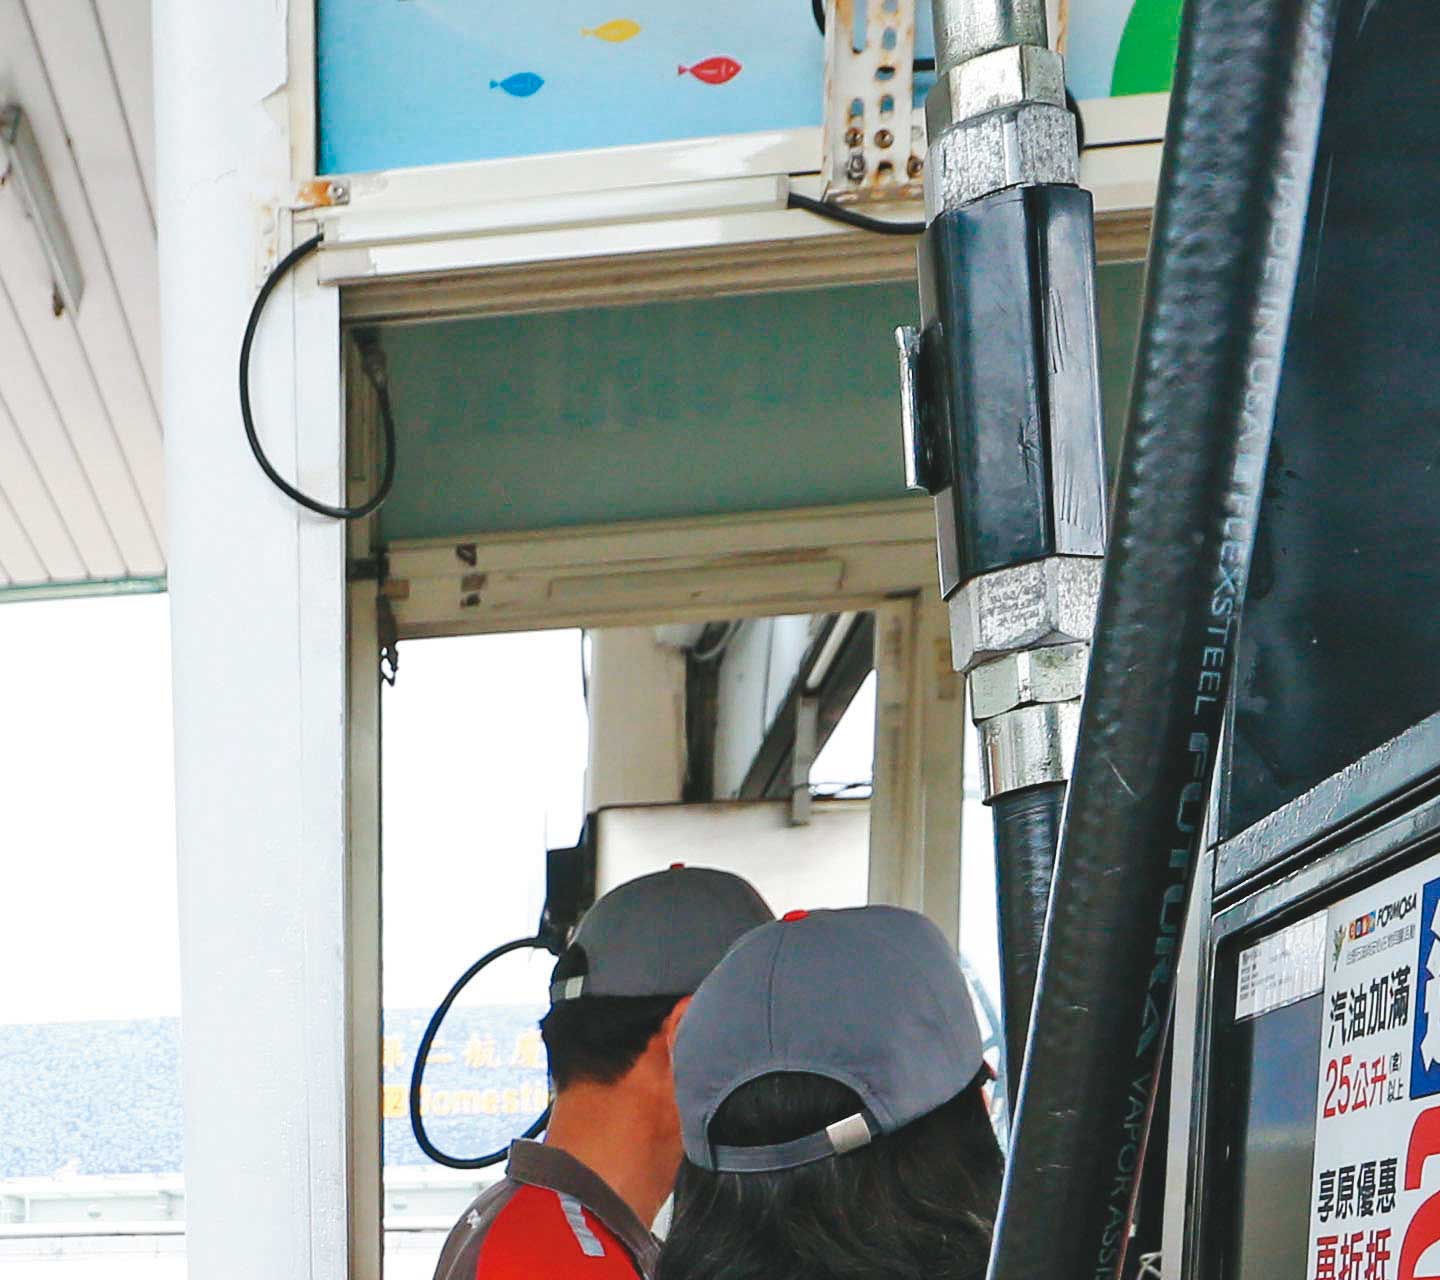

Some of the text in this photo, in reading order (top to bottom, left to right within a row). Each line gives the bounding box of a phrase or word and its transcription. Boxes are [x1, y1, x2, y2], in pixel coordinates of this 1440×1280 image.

[1376, 892, 1417, 928] FORMOSA
[1328, 964, 1411, 1049] 汽油加滿
[1323, 1054, 1387, 1119] 25公升
[1110, 1071, 1153, 1197] VAPOR
[1316, 1154, 1398, 1223] 享原優惠
